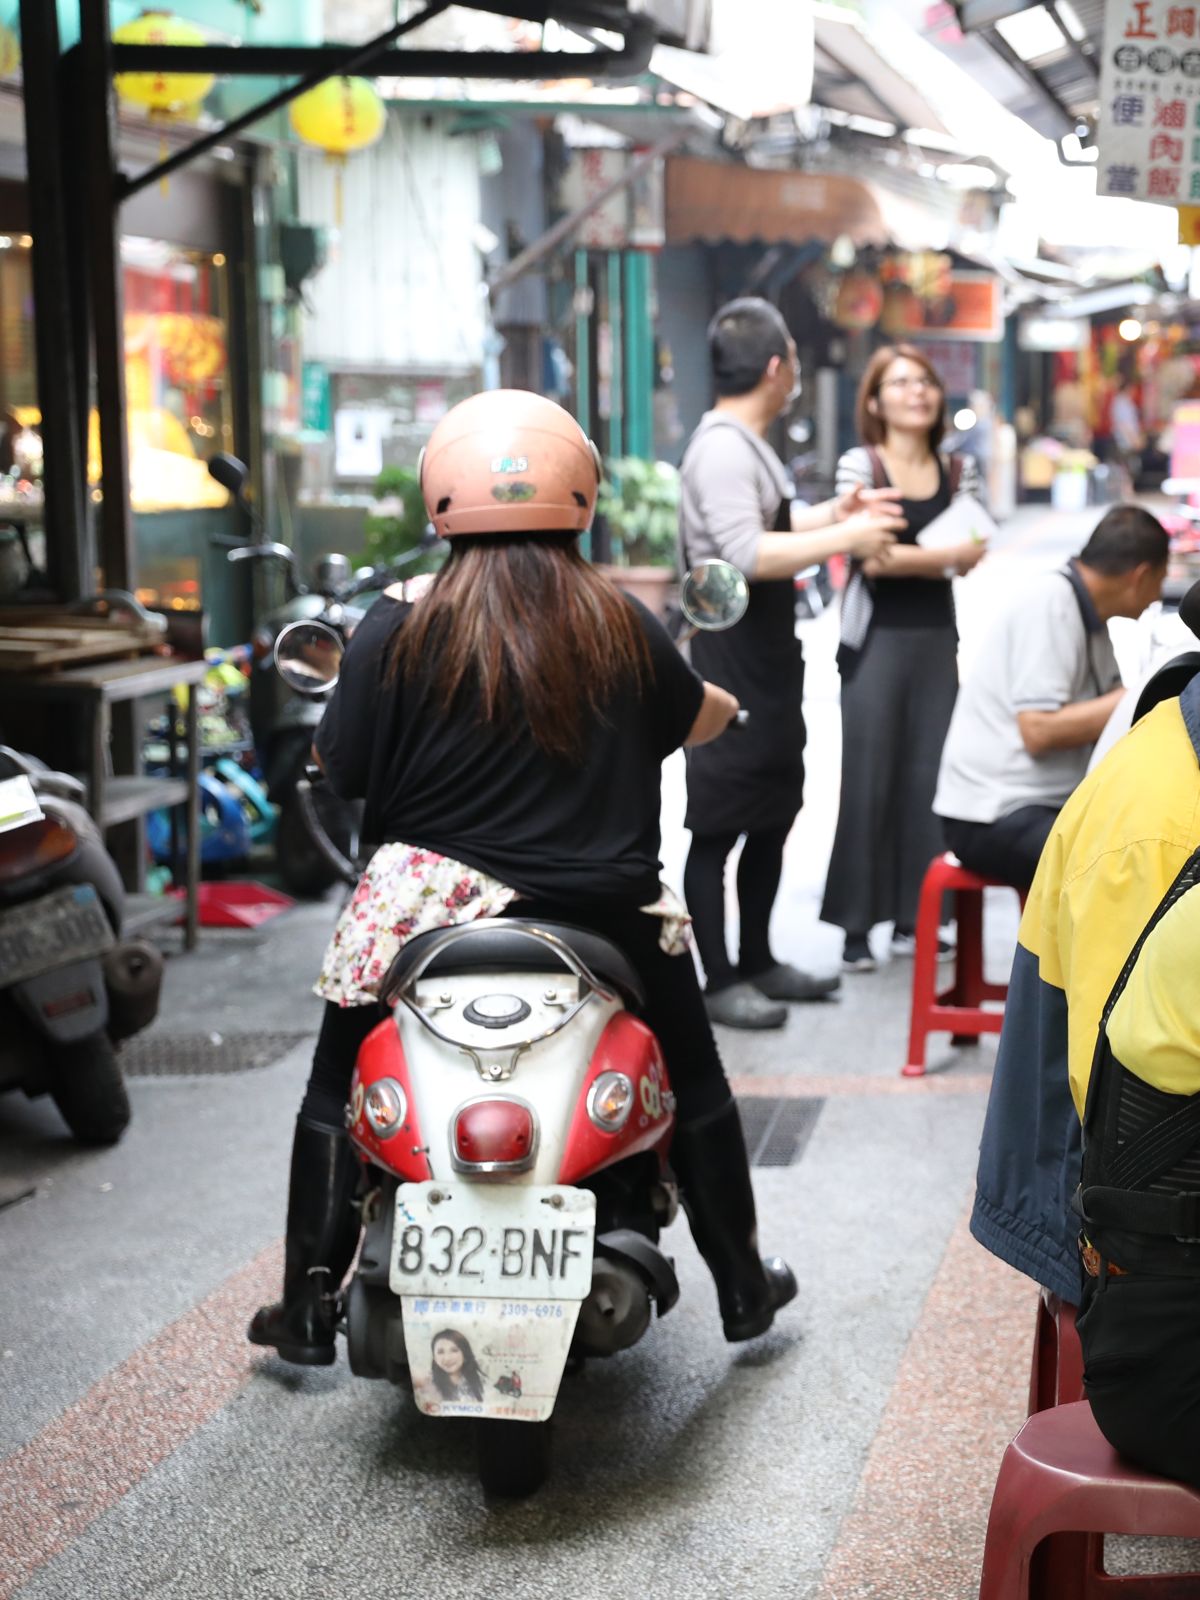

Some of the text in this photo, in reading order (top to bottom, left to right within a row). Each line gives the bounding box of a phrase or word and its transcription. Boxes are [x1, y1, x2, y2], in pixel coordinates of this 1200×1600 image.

[1107, 95, 1143, 193] 便當
[1147, 97, 1187, 199] 滷肉飯
[501, 1303, 563, 1318] 2309-6976
[443, 1404, 484, 1413] KYMCO
